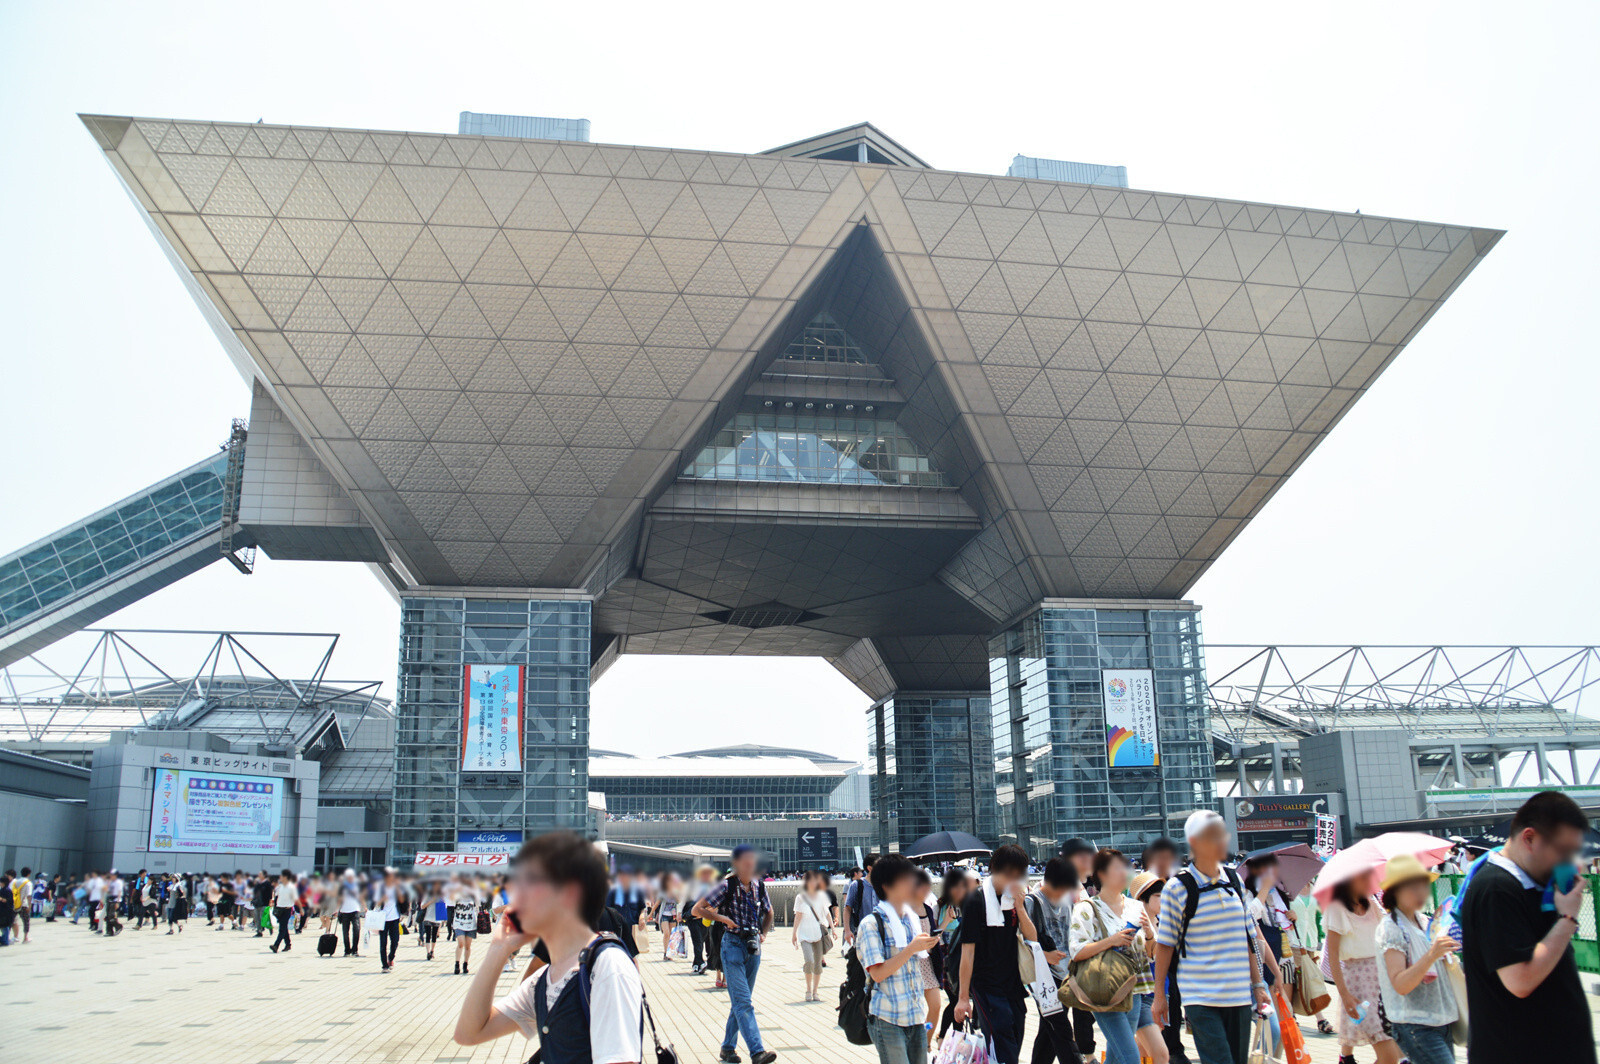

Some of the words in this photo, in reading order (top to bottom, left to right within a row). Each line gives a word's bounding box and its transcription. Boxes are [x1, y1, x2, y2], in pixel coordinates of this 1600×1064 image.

[500, 675, 510, 767] スポーツ祭東京2013
[190, 756, 268, 770] 東京ビッグサイト
[160, 773, 173, 834] キネマシトラス
[1283, 803, 1311, 811] GALLERY
[154, 838, 173, 848] 644
[1319, 820, 1327, 849] 販売中
[1326, 820, 1335, 854] カタログ
[418, 853, 505, 866] カタログ
[1040, 982, 1056, 1000] 和
